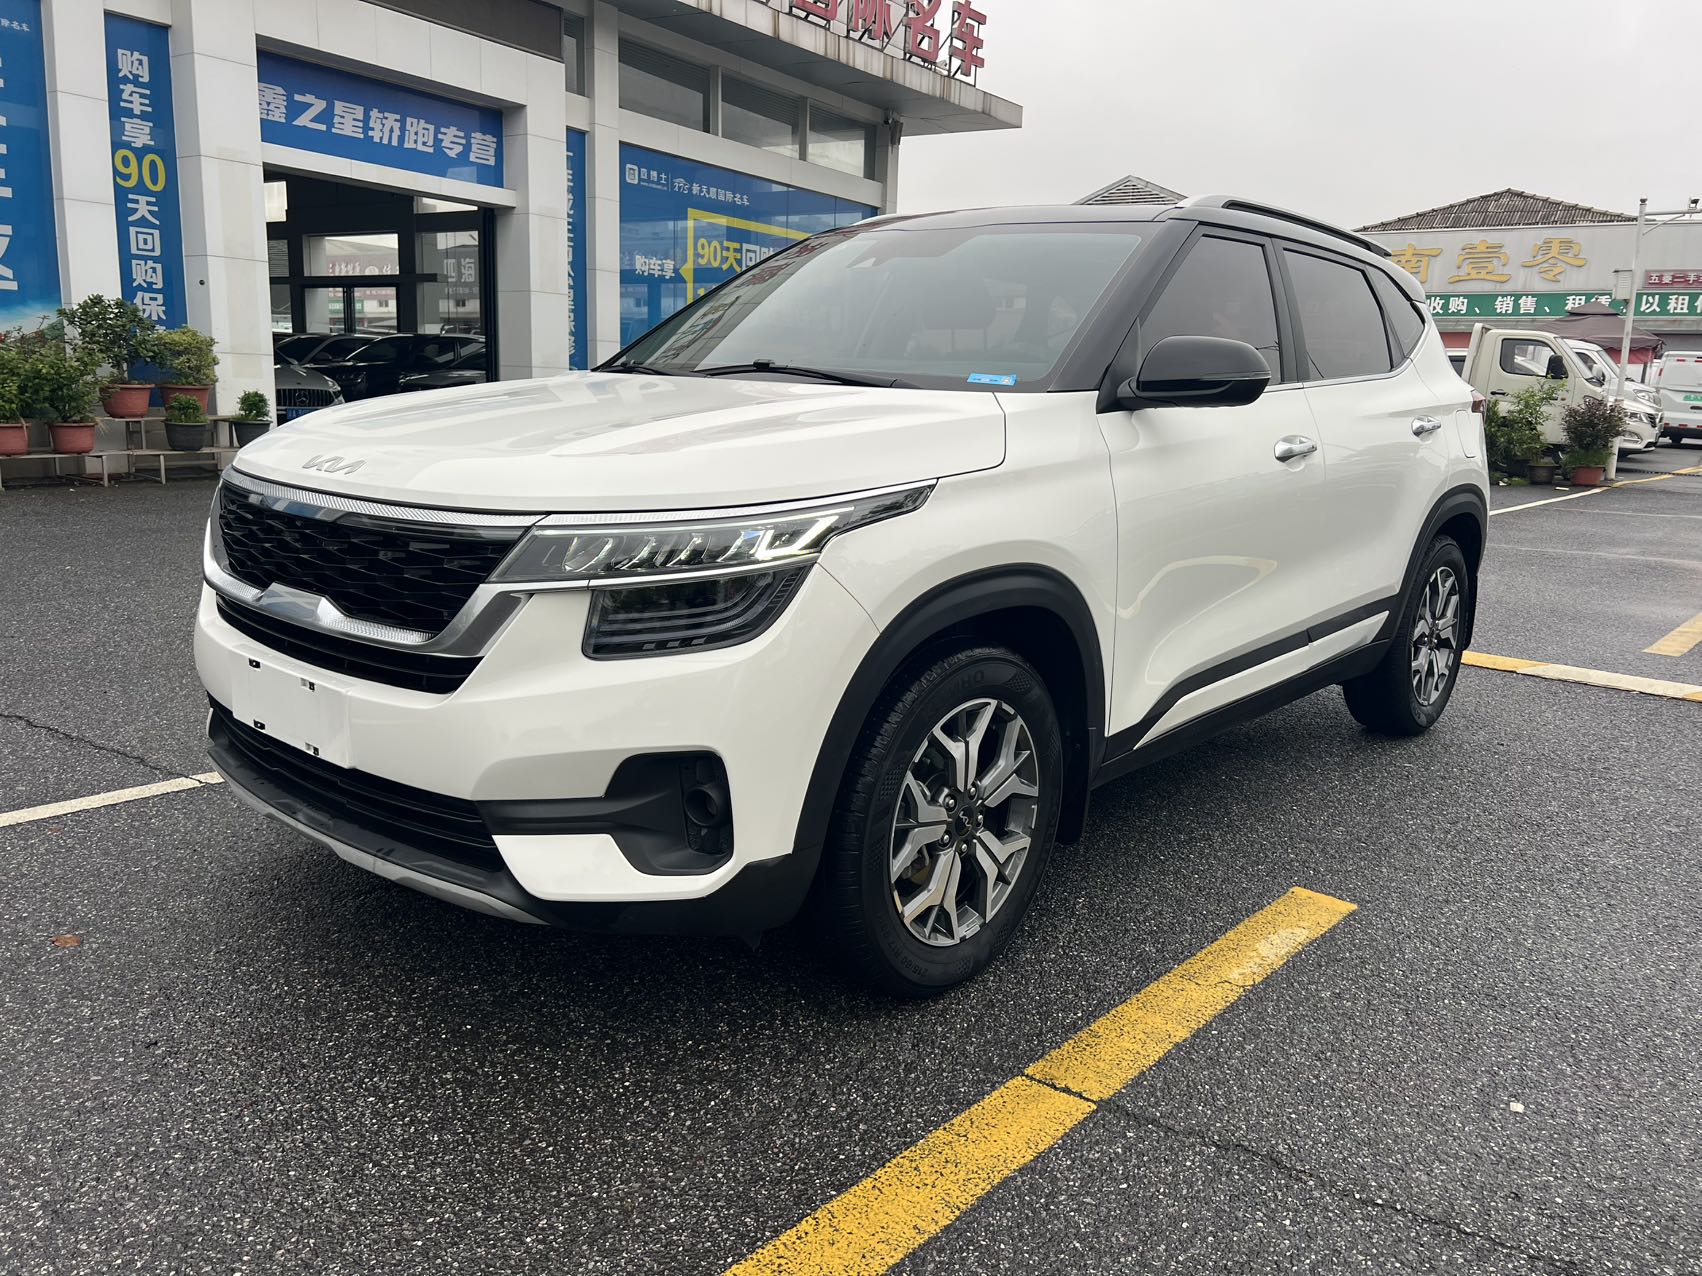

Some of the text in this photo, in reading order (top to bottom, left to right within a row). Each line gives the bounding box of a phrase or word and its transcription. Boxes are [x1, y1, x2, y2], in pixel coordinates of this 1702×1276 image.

[796, 0, 987, 77] 际名车
[258, 82, 497, 166] 鑫之星轿跑专营
[113, 49, 167, 333] 购车享90天回购保
[635, 255, 675, 279] 购车享
[302, 454, 366, 475] KIA
